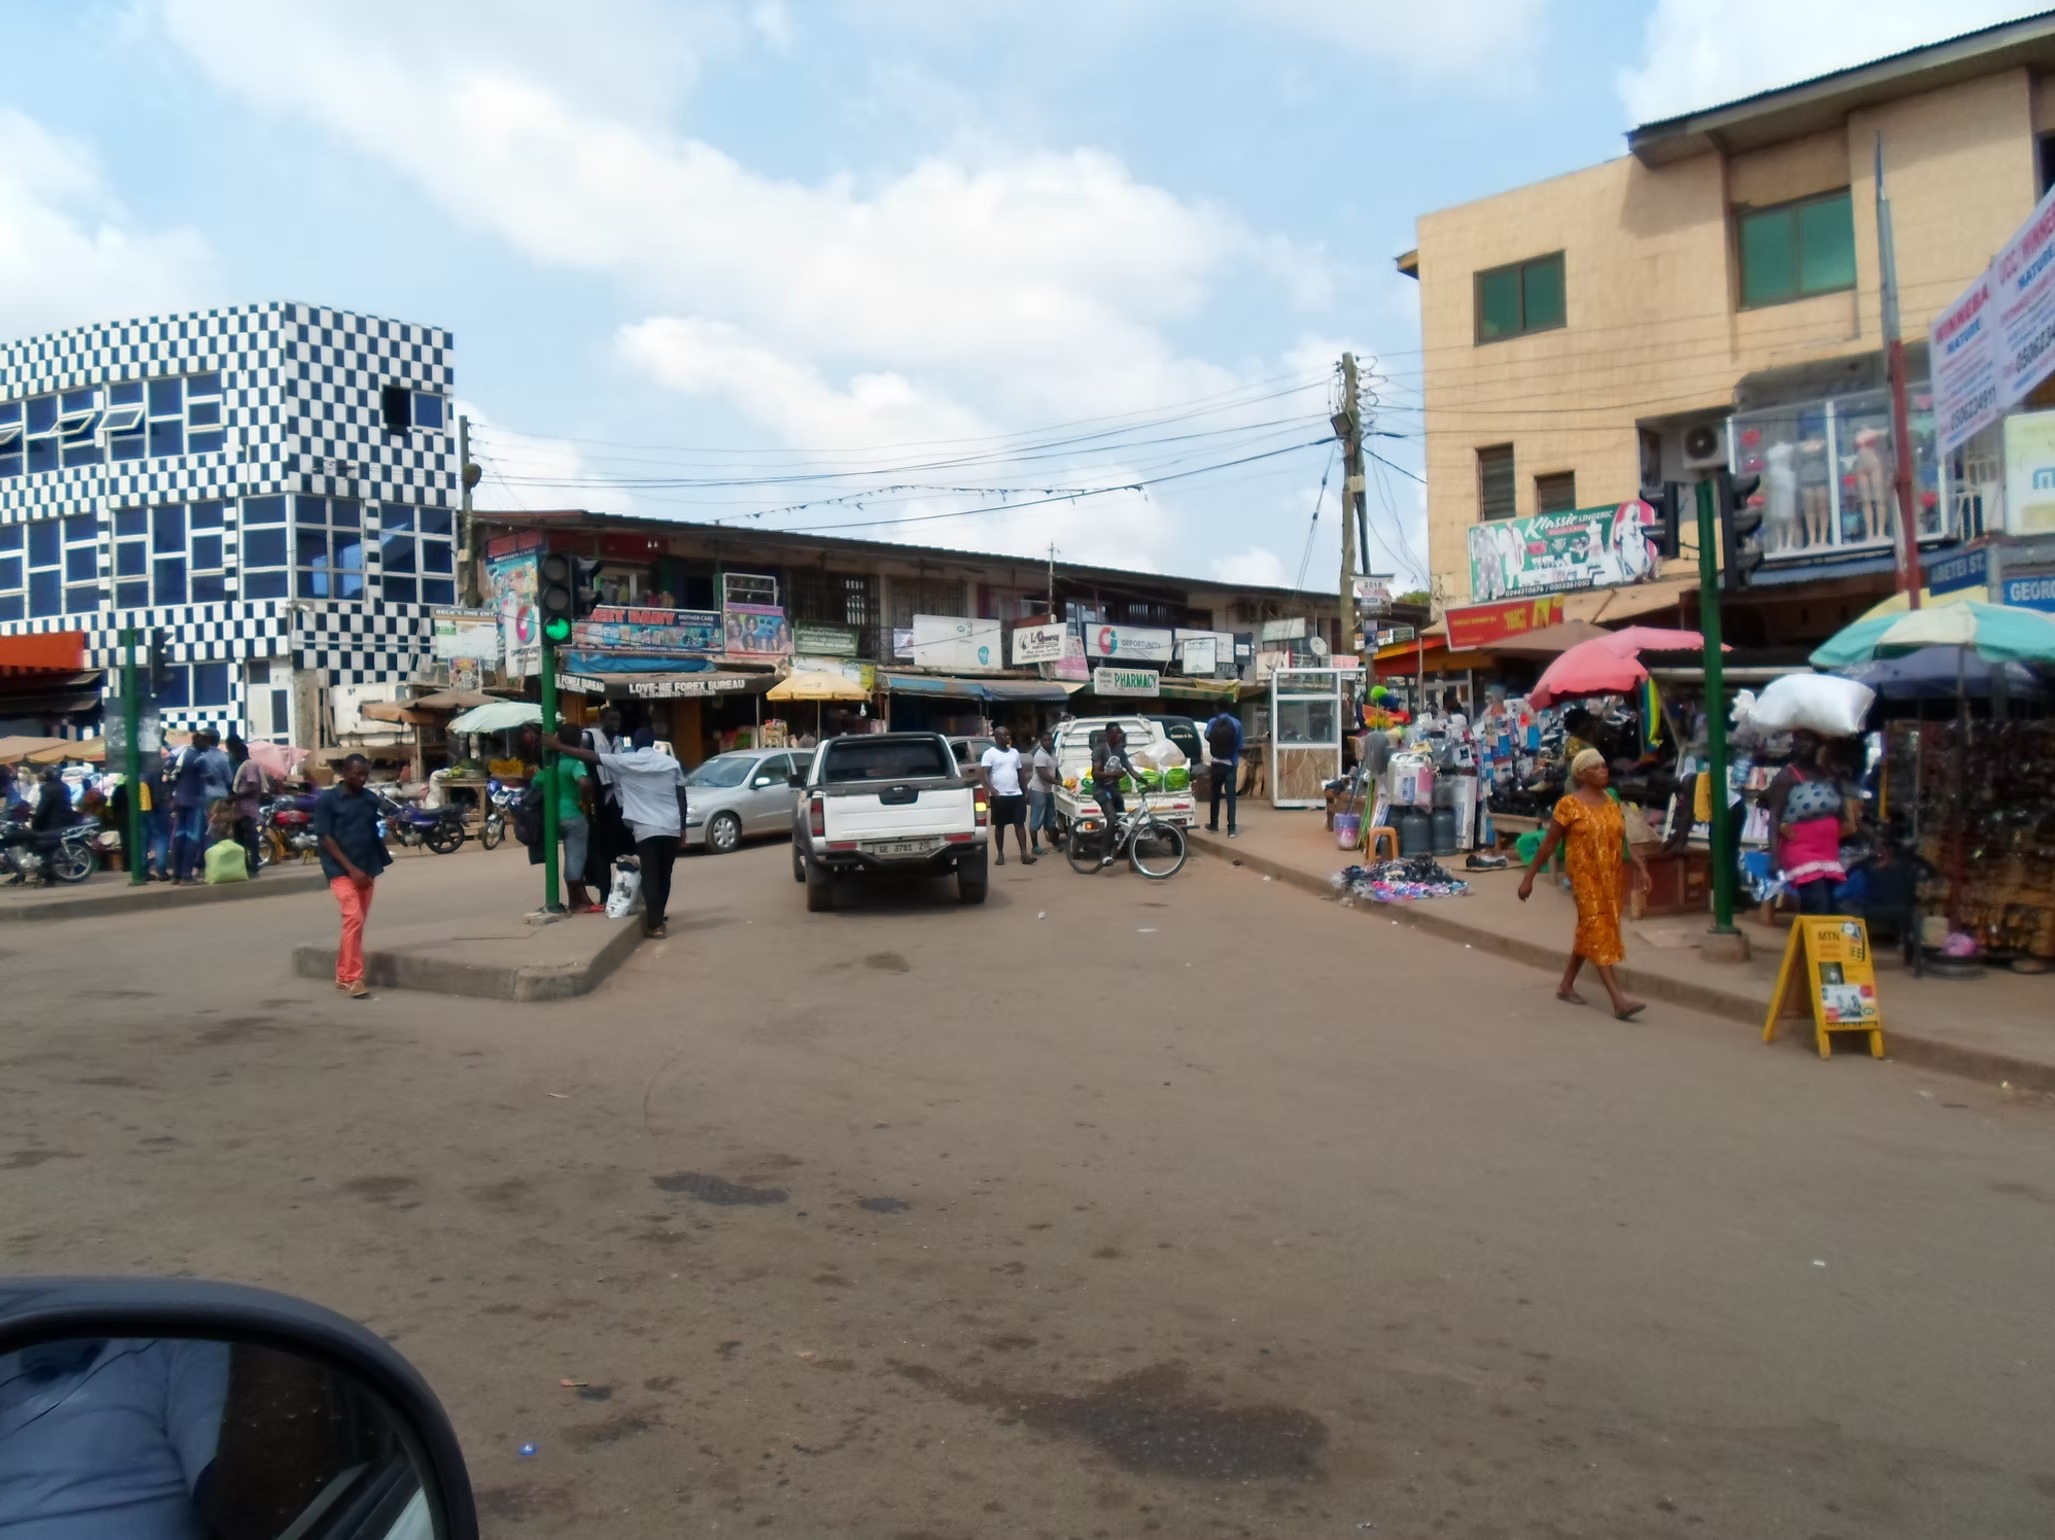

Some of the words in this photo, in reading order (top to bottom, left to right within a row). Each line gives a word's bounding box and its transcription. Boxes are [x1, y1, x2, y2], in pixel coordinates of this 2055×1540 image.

[1121, 639, 1161, 649] OPPORTUNITY
[674, 681, 705, 692] FOREX
[708, 679, 745, 690] BUREAU
[1114, 672, 1158, 688] PHARMACY
[1818, 931, 1840, 941] MTN
